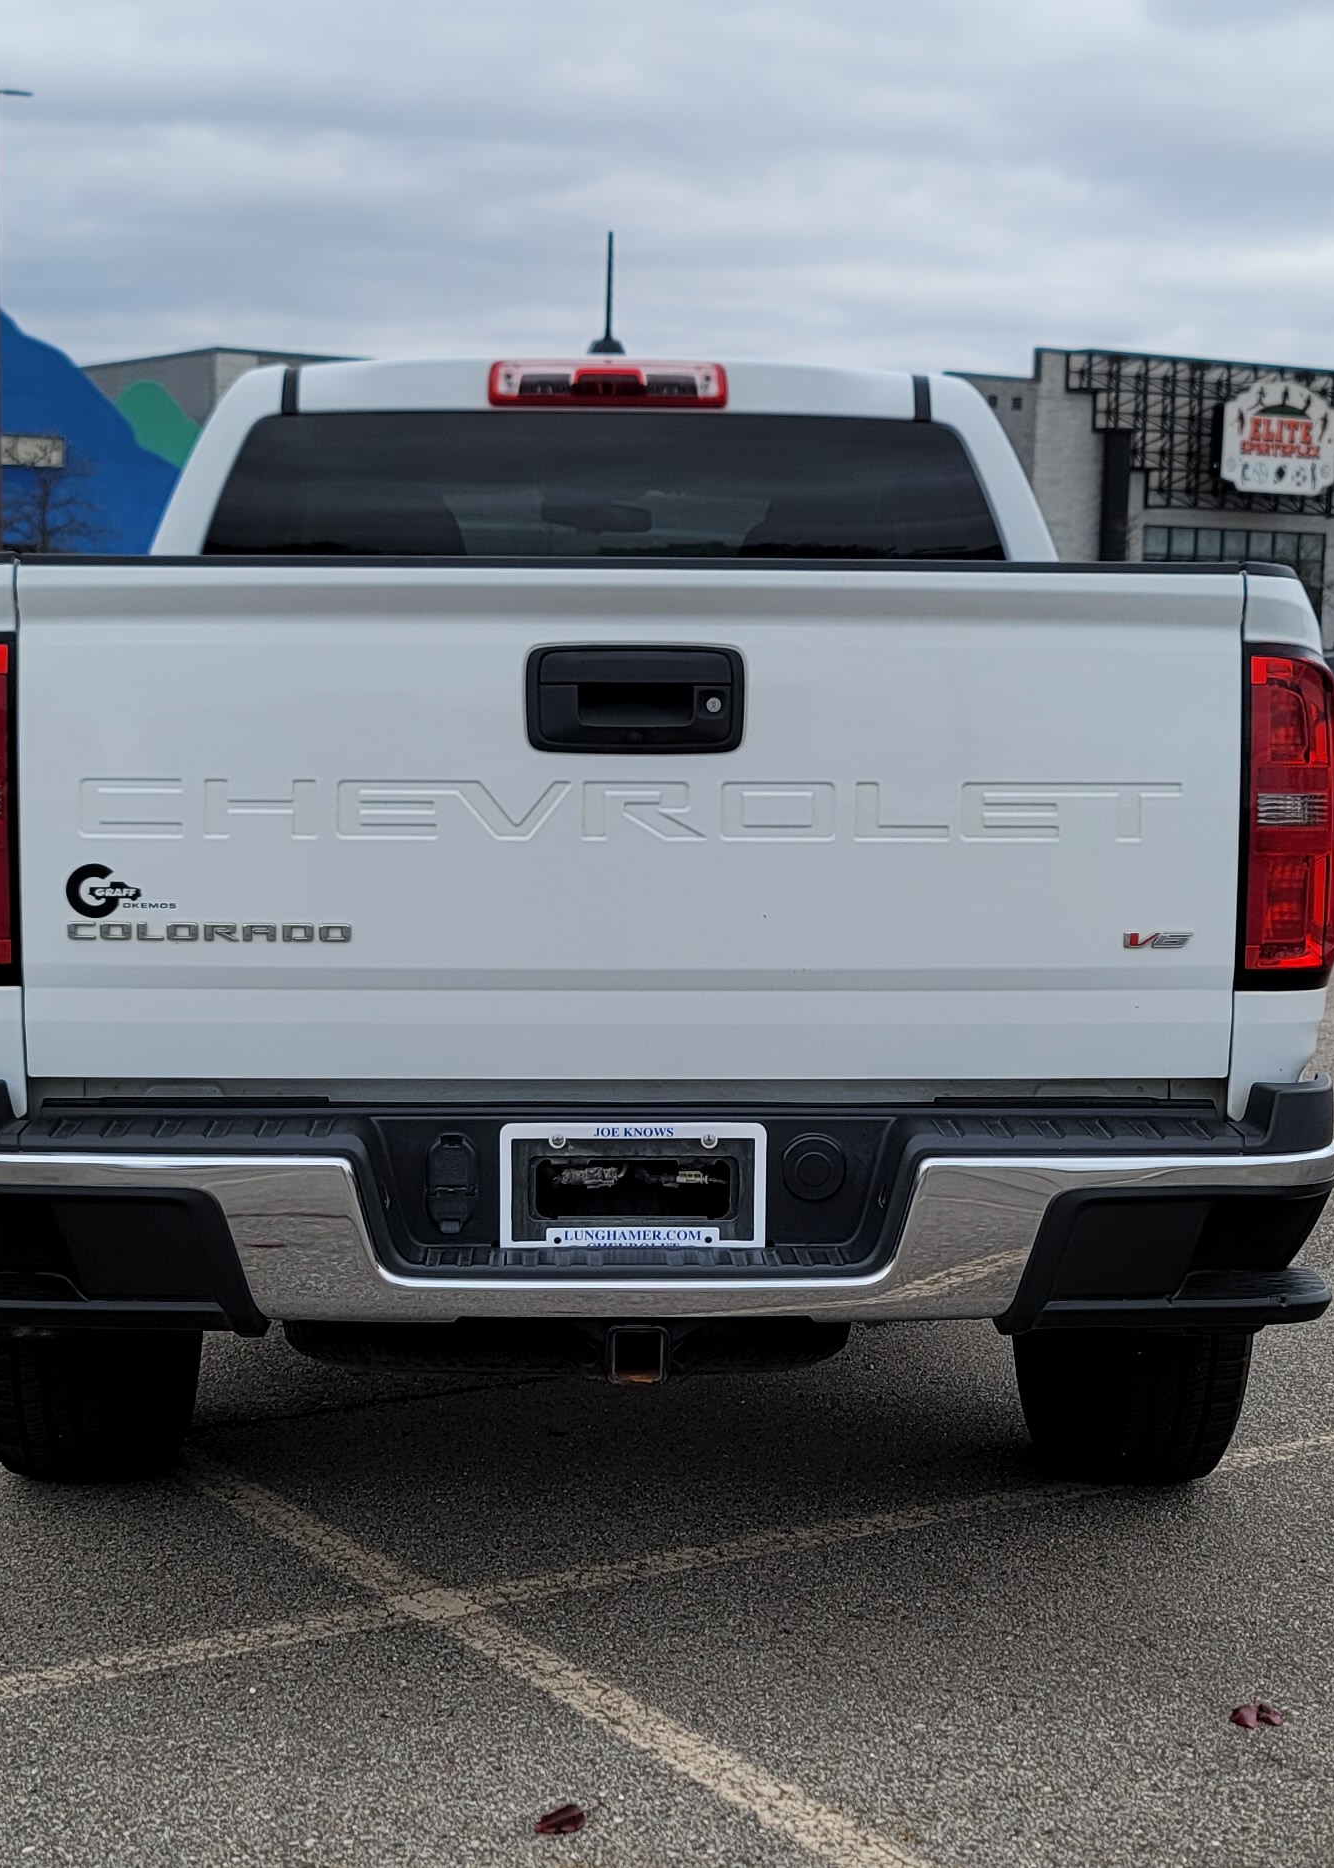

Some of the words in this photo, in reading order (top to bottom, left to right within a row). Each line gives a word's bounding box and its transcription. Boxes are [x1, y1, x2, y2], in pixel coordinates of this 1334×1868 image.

[1250, 416, 1313, 444] ELITE
[78, 778, 1184, 843] CHEVROLET
[93, 887, 137, 898] GRAFF
[122, 902, 177, 910] OKEMOS
[67, 921, 352, 943] COLORADO
[1123, 931, 1193, 949] V6
[593, 1127, 620, 1138] JOE
[623, 1127, 674, 1138] KNOWS
[564, 1230, 702, 1241] LUNGHAMER.COM
